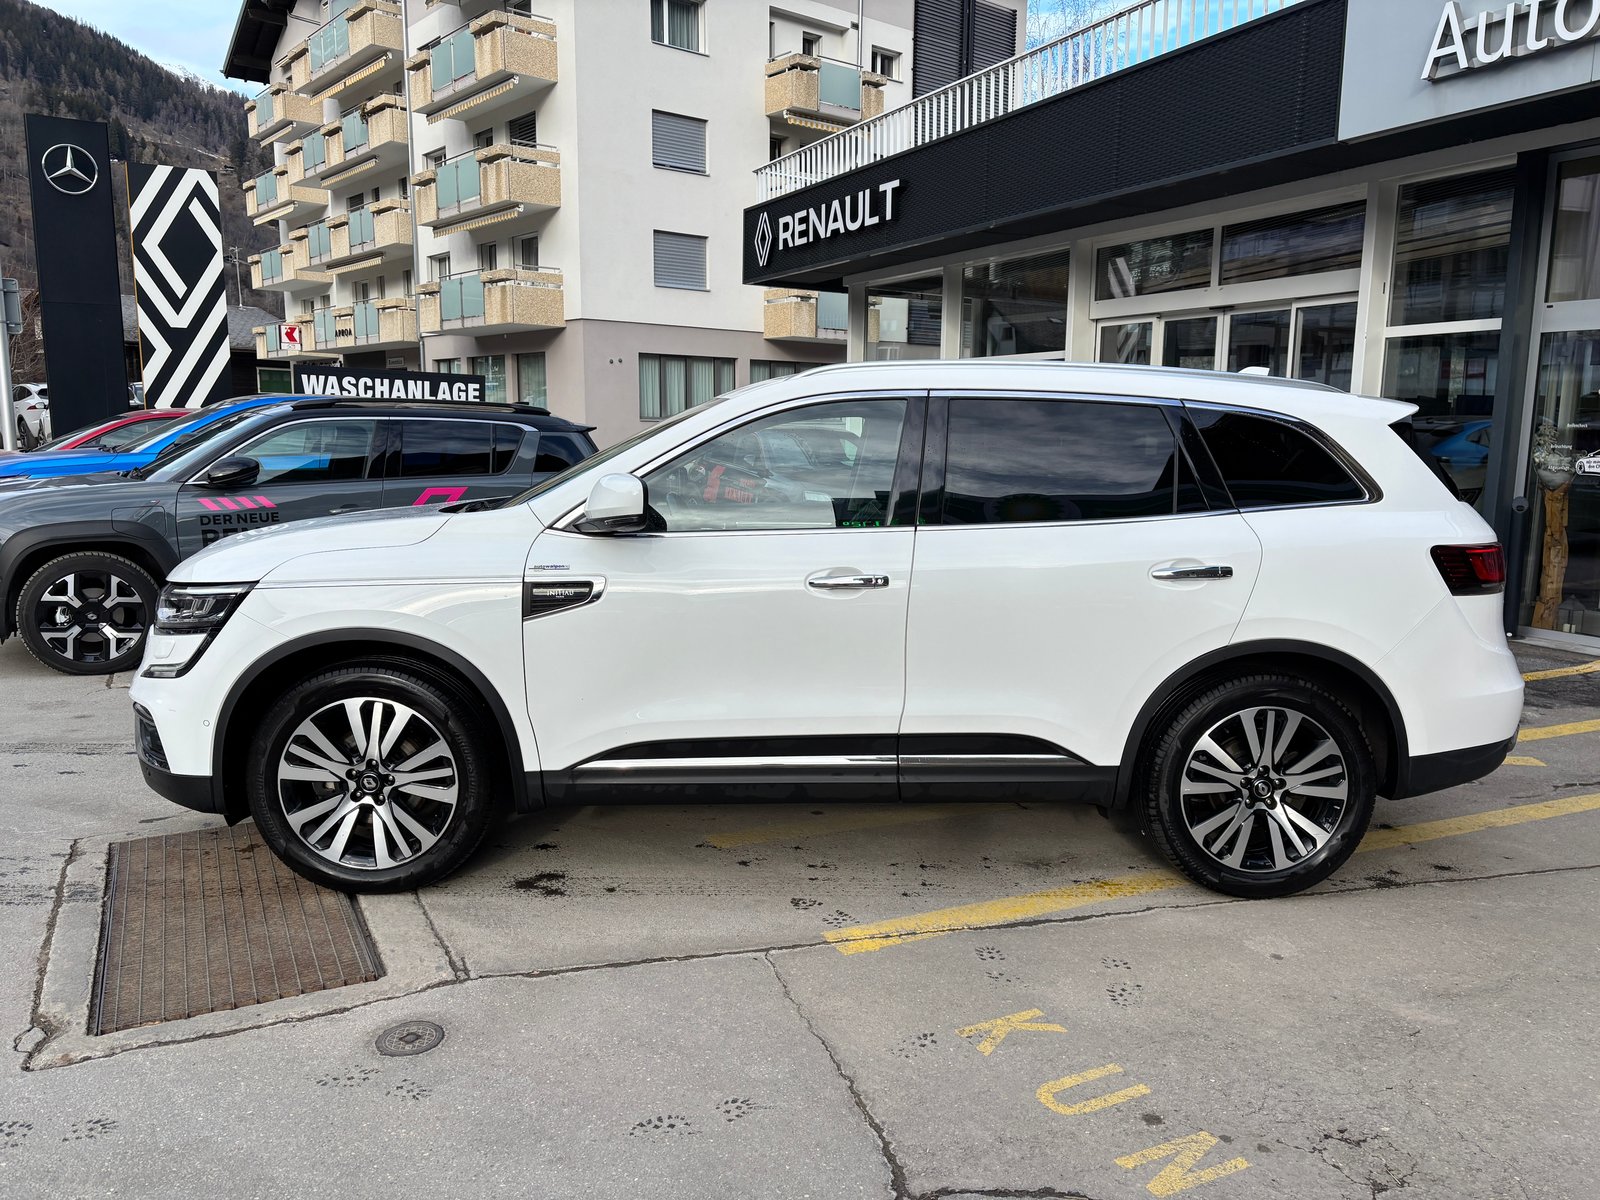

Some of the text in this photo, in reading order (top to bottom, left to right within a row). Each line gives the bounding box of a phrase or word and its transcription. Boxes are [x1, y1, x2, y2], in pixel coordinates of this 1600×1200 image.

[1420, 0, 1600, 80] Auto
[778, 179, 900, 250] RENAULT
[301, 374, 480, 401] WASCHANLAGE
[200, 512, 280, 526] DER NEUE
